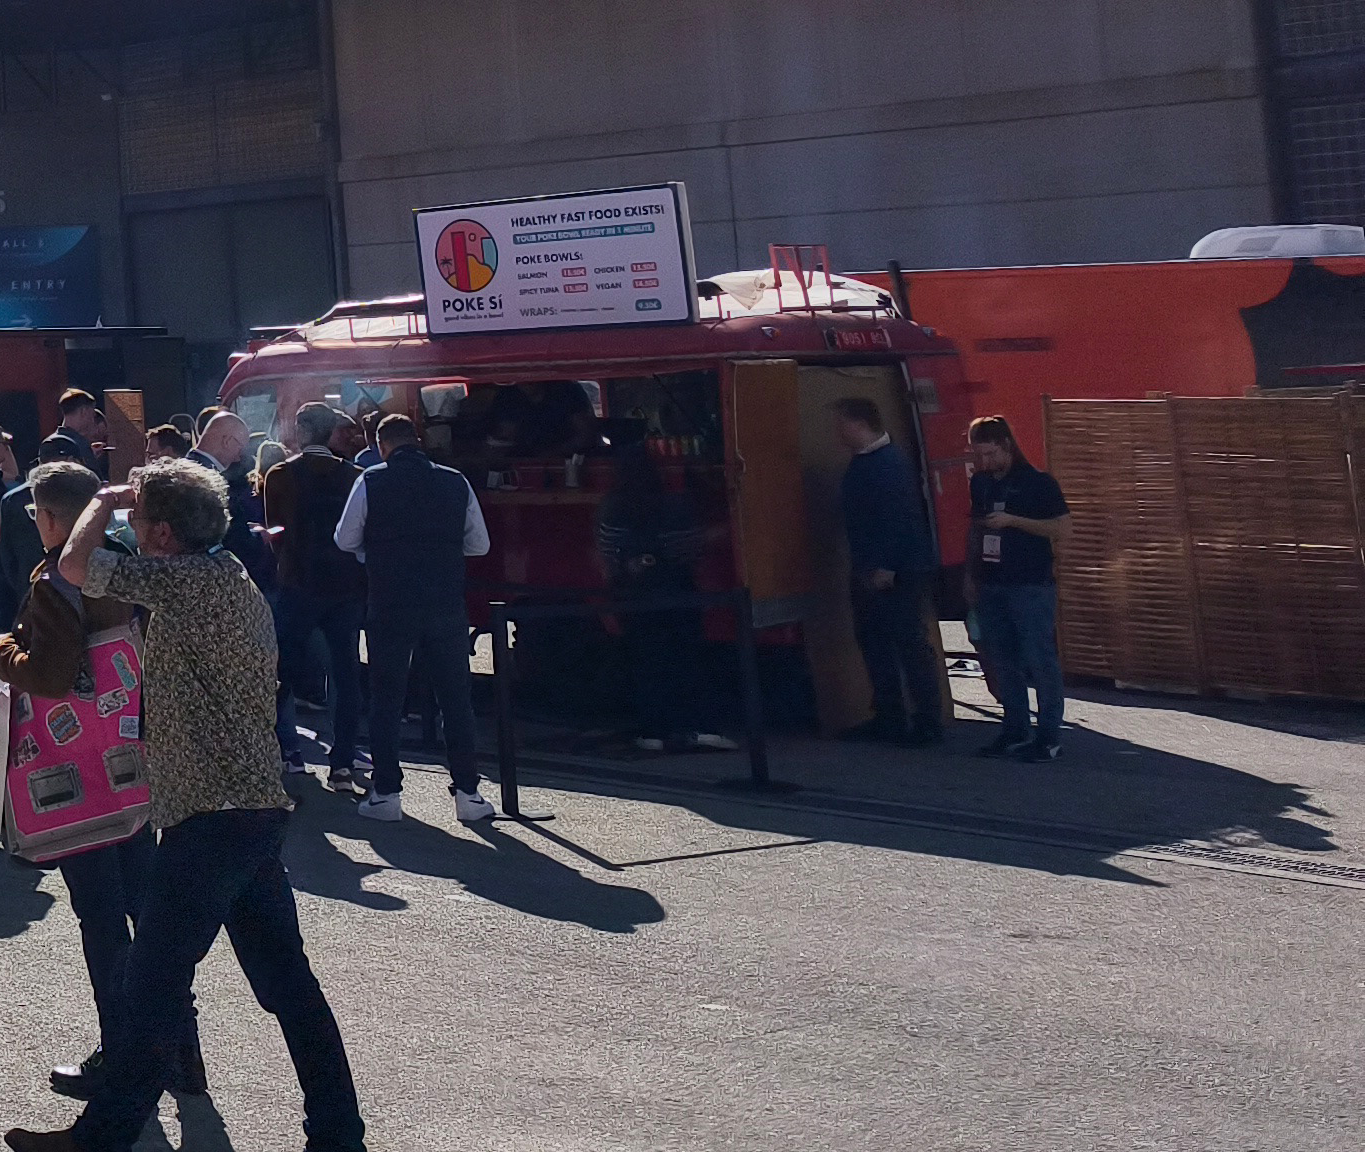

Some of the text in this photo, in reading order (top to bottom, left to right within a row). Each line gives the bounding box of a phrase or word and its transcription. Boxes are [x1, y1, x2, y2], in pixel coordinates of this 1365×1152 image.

[510, 214, 558, 227] HEALTHY
[561, 212, 585, 223] FAST
[589, 208, 621, 220] FOOD
[515, 255, 541, 264] POKE
[11, 279, 66, 290] ENTRY
[595, 282, 622, 290] VEGAN
[442, 297, 485, 312] POKE
[520, 307, 557, 316] WRAPS:
